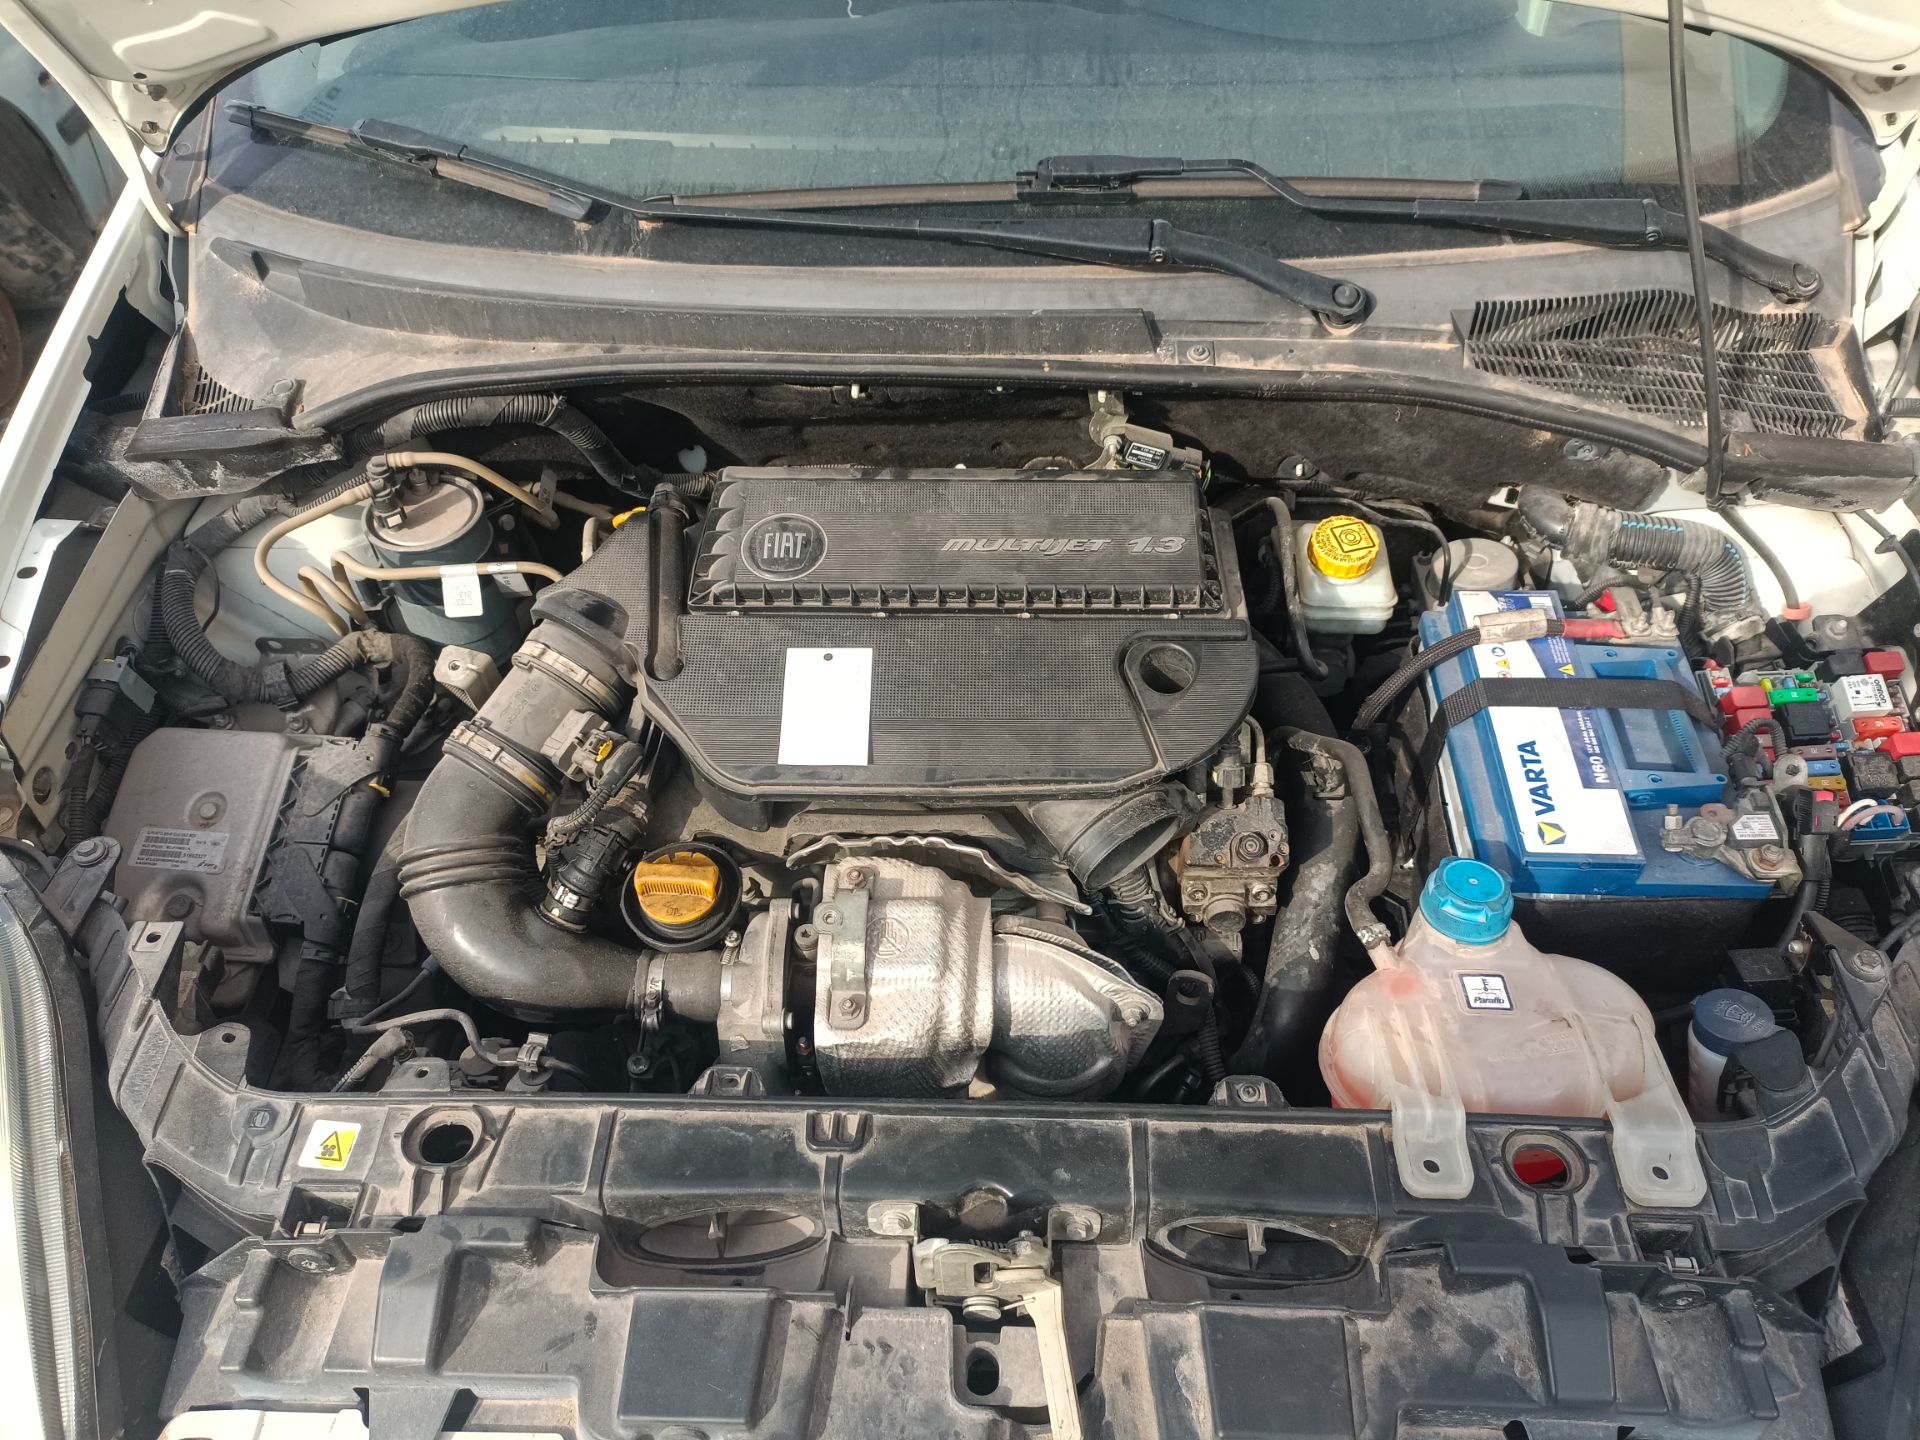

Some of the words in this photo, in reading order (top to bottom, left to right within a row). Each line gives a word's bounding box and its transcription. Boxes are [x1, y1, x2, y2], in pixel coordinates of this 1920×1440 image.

[763, 532, 807, 559] FIAT
[941, 538, 1112, 556] MULTIJET
[1128, 536, 1187, 553] 1.3
[1874, 679, 1887, 704] omron
[1517, 739, 1556, 817] VARTA
[1589, 755, 1610, 784] N60
[1474, 996, 1505, 1004] Paraflu
